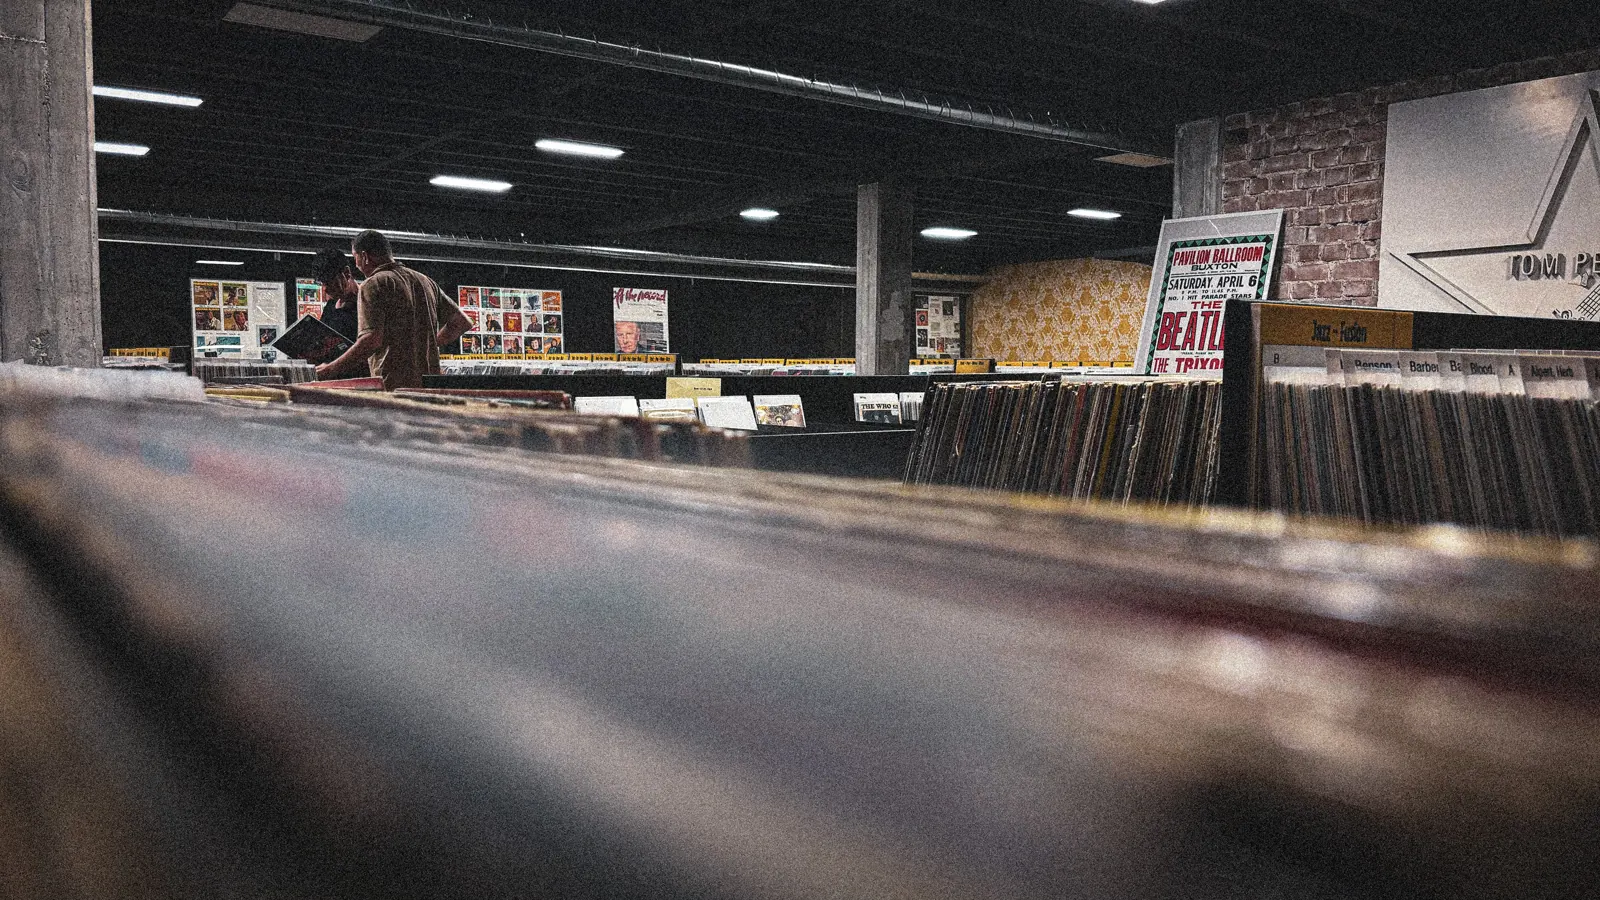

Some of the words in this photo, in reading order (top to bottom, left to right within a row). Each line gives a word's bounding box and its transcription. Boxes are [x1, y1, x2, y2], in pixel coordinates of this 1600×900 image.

[1173, 249, 1212, 266] PAVILION
[1212, 246, 1264, 263] BALLROOM
[1191, 263, 1238, 271] BUXTON
[1506, 254, 1564, 280] TOM
[1216, 275, 1244, 289] APRIL
[1248, 275, 1258, 288] 6
[1191, 301, 1223, 309] THE
[1311, 319, 1331, 342] Jazz
[1340, 320, 1367, 343] Fusion
[1153, 358, 1169, 373] THE
[1273, 353, 1280, 365] B
[1508, 364, 1515, 376] A
